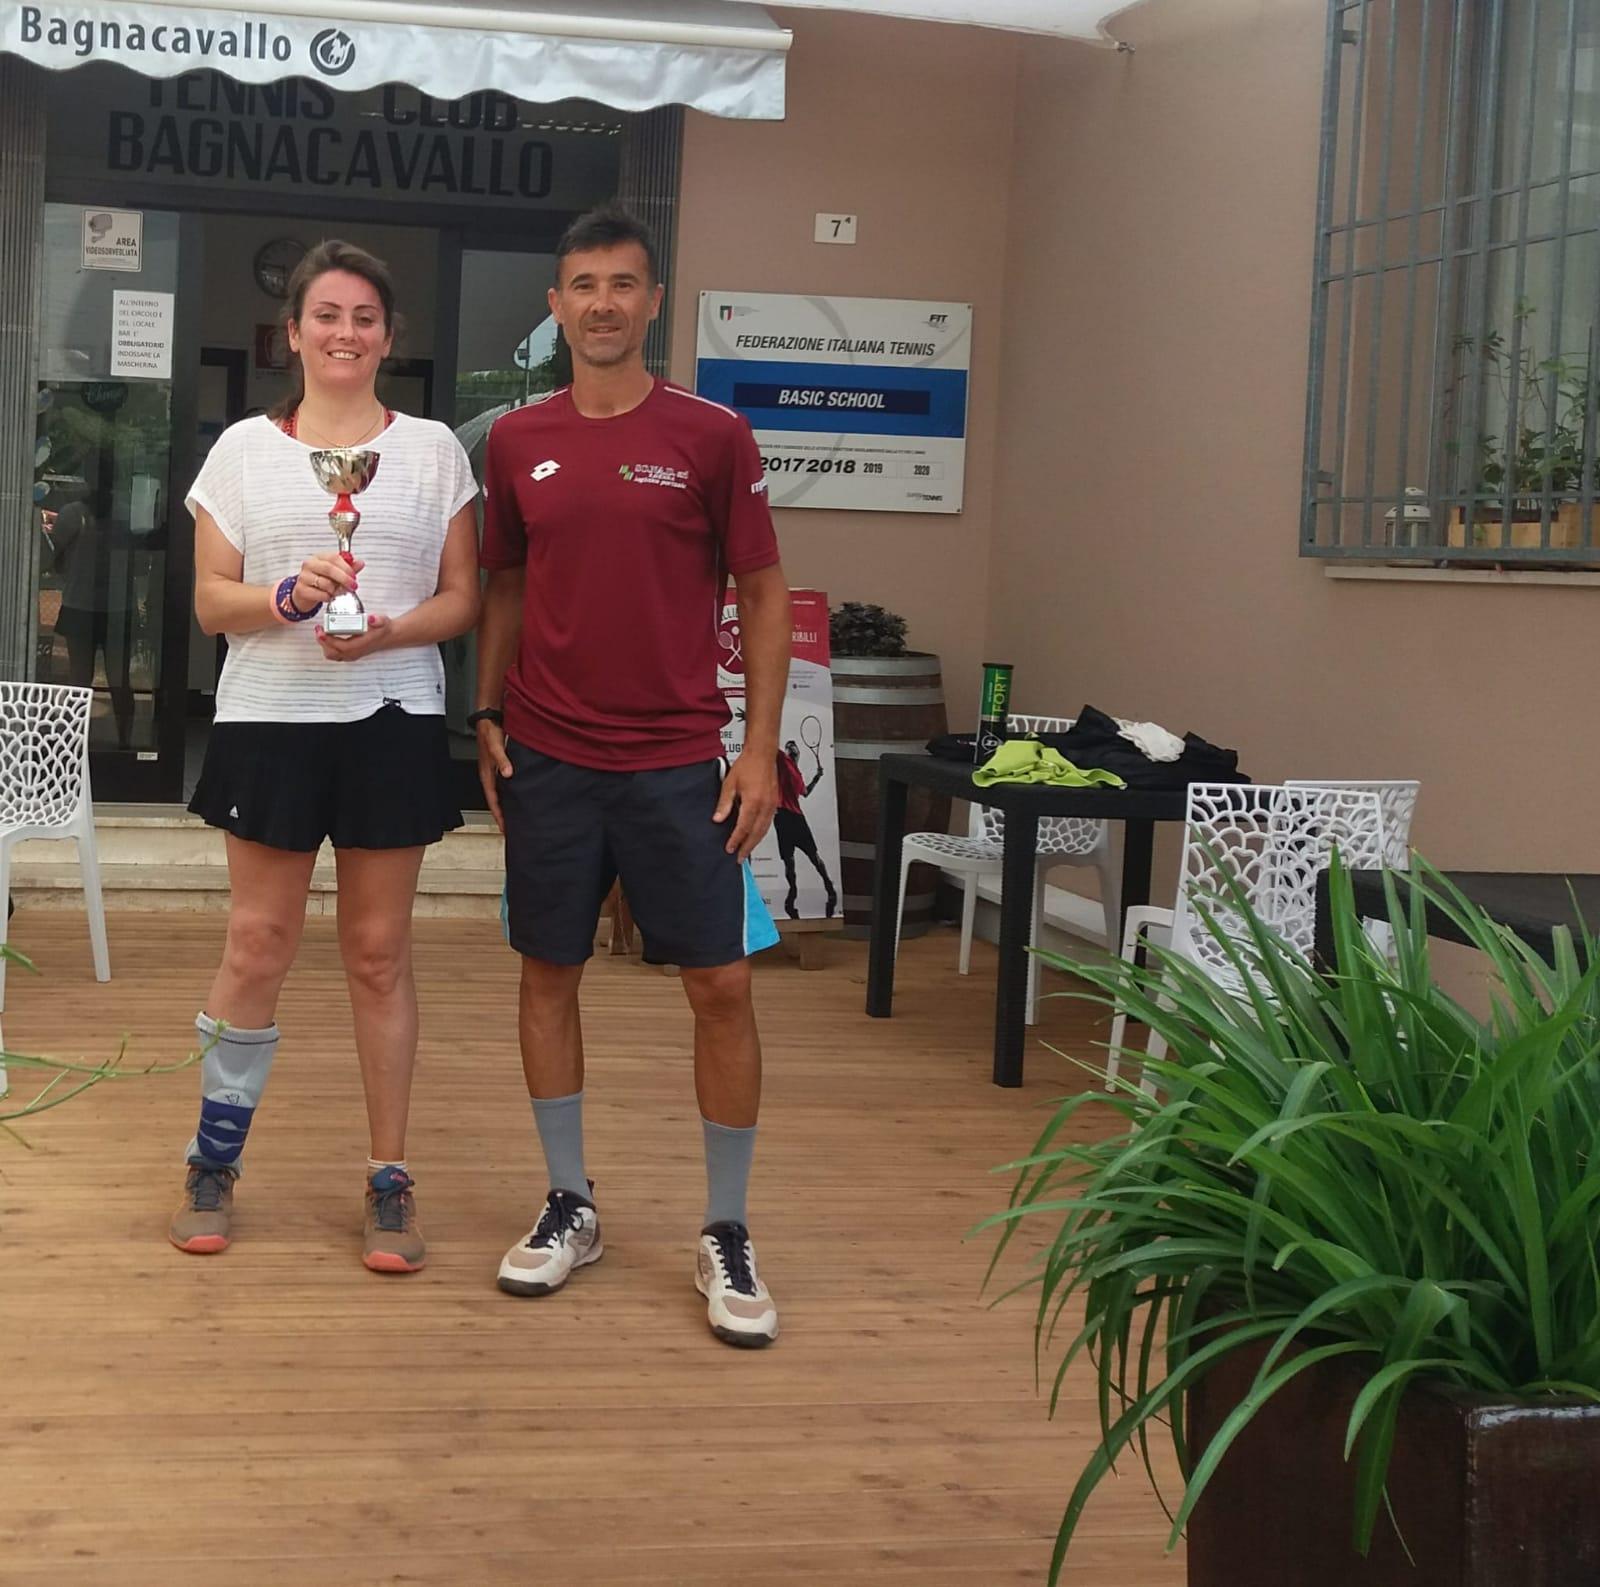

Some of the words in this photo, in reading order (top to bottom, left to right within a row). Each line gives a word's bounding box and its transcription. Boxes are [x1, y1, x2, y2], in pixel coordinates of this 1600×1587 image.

[20, 7, 292, 62] Bagnacavallo
[108, 110, 553, 198] BAGNACAVALLO
[116, 237, 137, 247] AREA
[118, 340, 164, 348] OBBLIGATORIO
[736, 334, 825, 352] FEDERAZIONE
[827, 339, 885, 355] ITALIANA
[889, 342, 936, 356] TENNIS
[117, 360, 158, 369] MASCHERINA
[779, 389, 824, 407] BASIC
[827, 391, 886, 409] SCHOOL
[761, 457, 805, 472] 2017
[806, 459, 856, 474] 2018
[863, 463, 883, 474] 2019
[993, 672, 1008, 714] FORT
